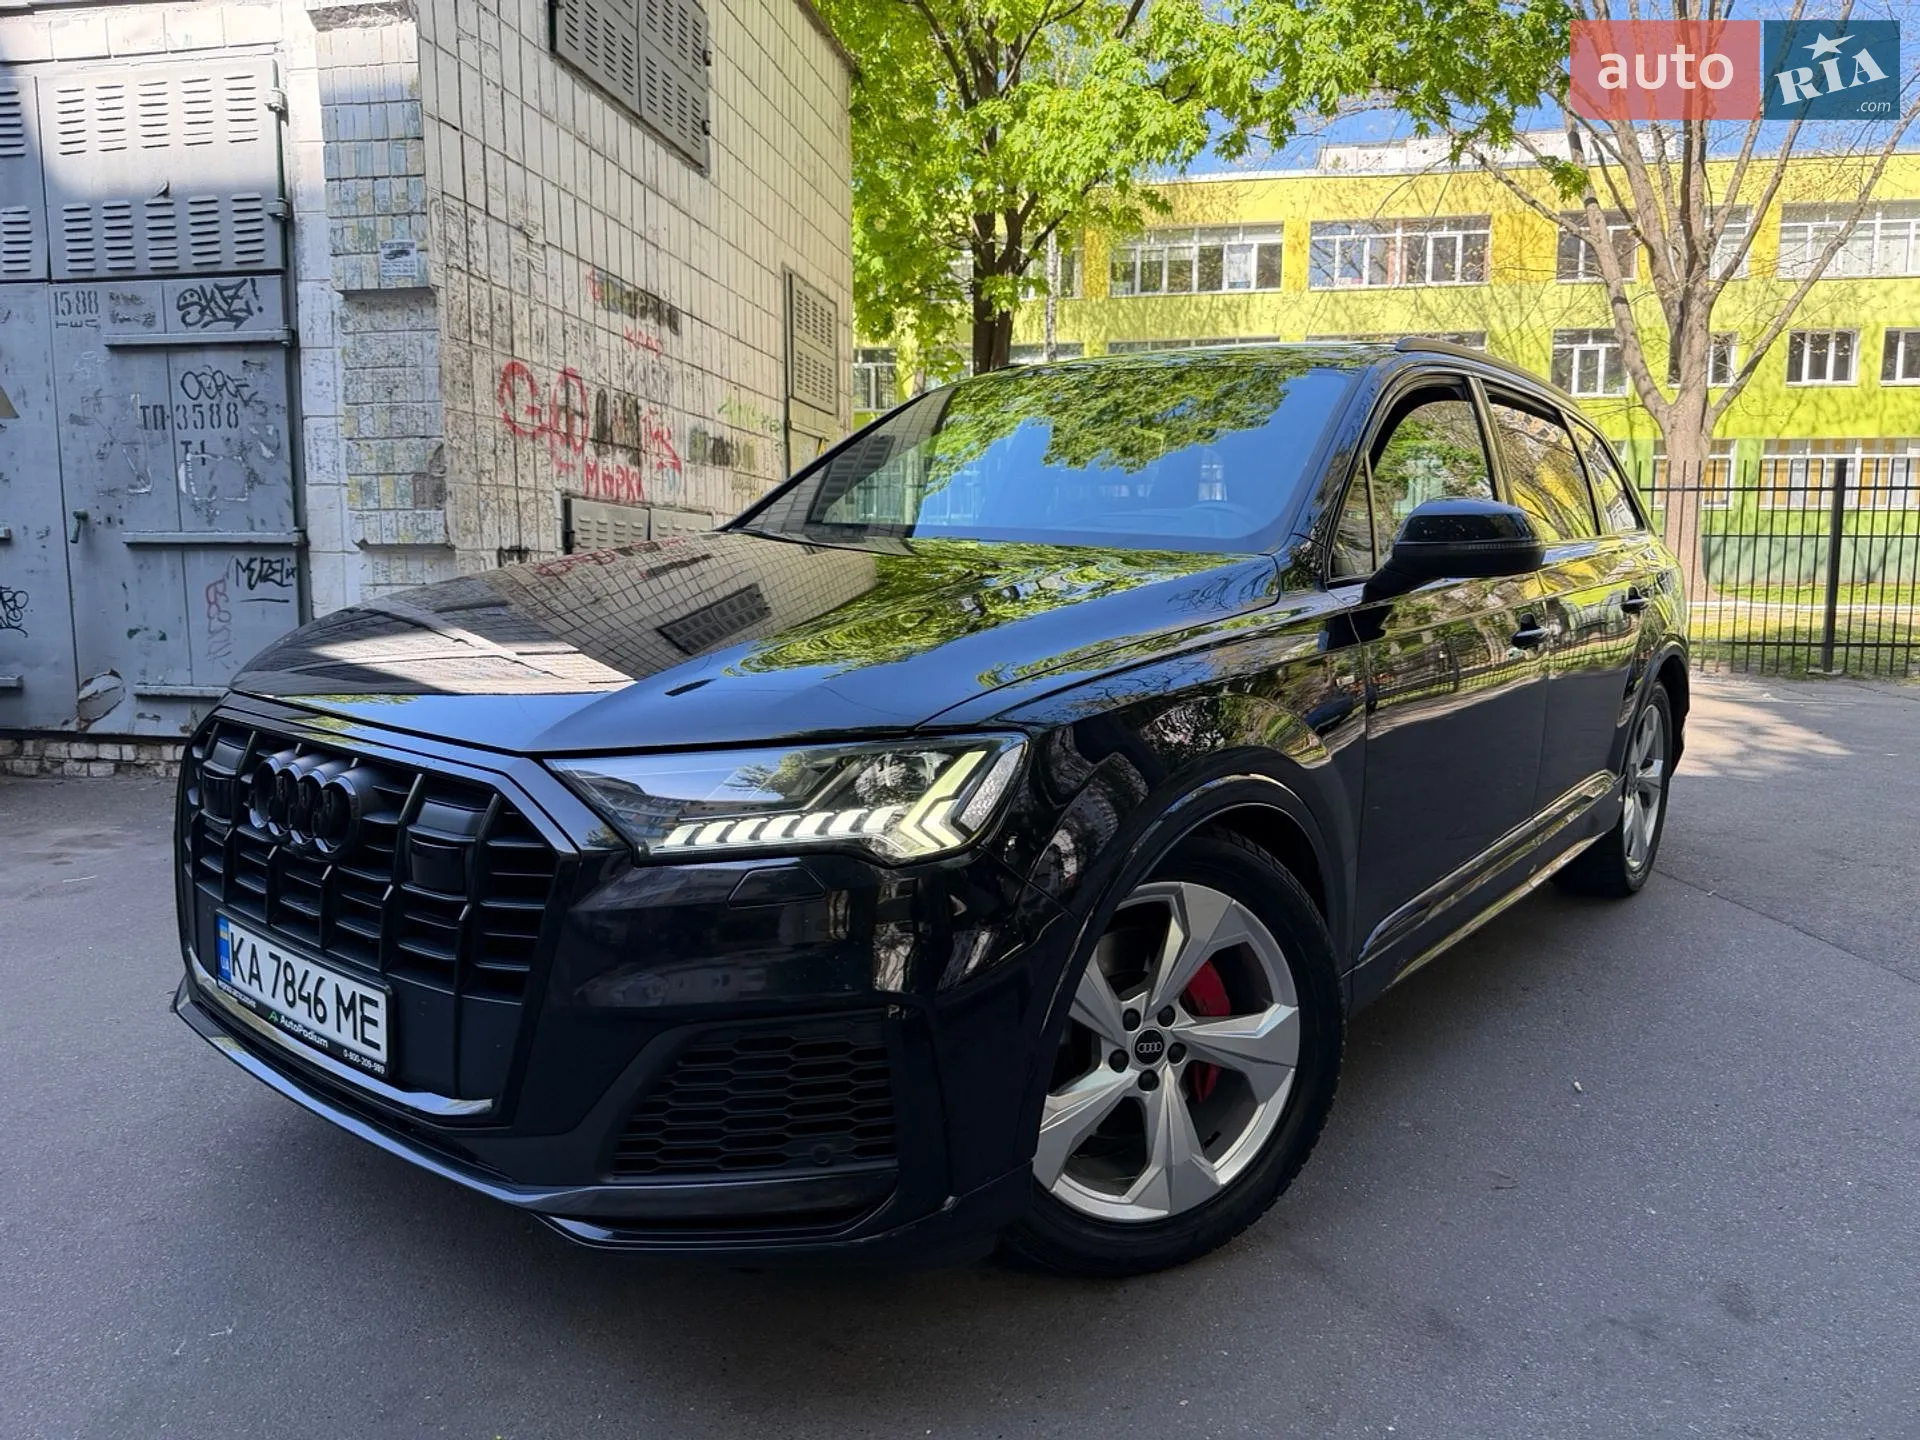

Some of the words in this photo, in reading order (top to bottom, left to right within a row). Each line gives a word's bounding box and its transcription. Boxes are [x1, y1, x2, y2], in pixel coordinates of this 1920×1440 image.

[54, 290, 99, 316] 1588
[230, 932, 263, 993] KA
[268, 951, 327, 1024] 7846
[335, 983, 381, 1051] ME
